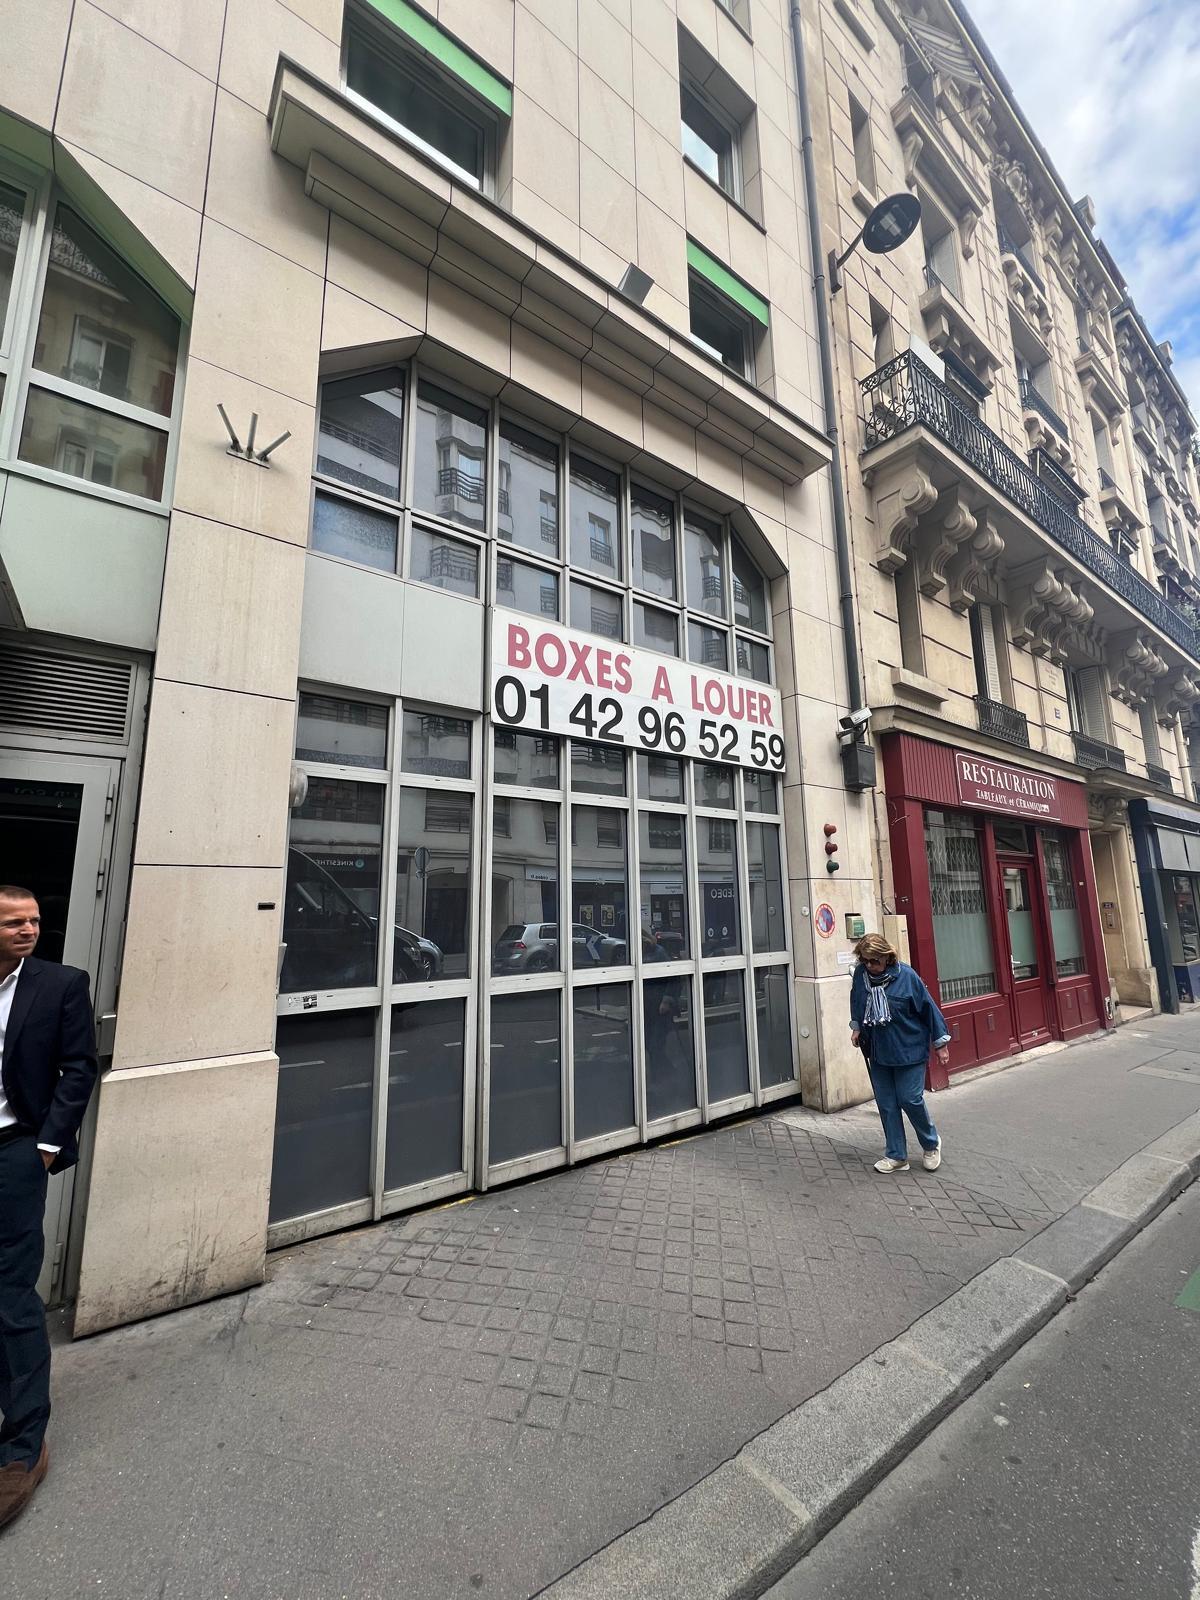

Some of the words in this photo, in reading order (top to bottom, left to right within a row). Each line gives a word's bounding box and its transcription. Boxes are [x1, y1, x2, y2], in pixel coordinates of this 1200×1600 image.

[507, 623, 633, 695] BOXES
[651, 665, 674, 704] A
[690, 674, 775, 727] LOUER
[494, 675, 550, 730] 01
[569, 693, 624, 743] 42
[637, 705, 687, 753] 96
[698, 718, 741, 763] 52
[750, 730, 786, 771] 59
[961, 760, 1055, 800] RESTAURATION
[976, 789, 1007, 804] TABLEAUX
